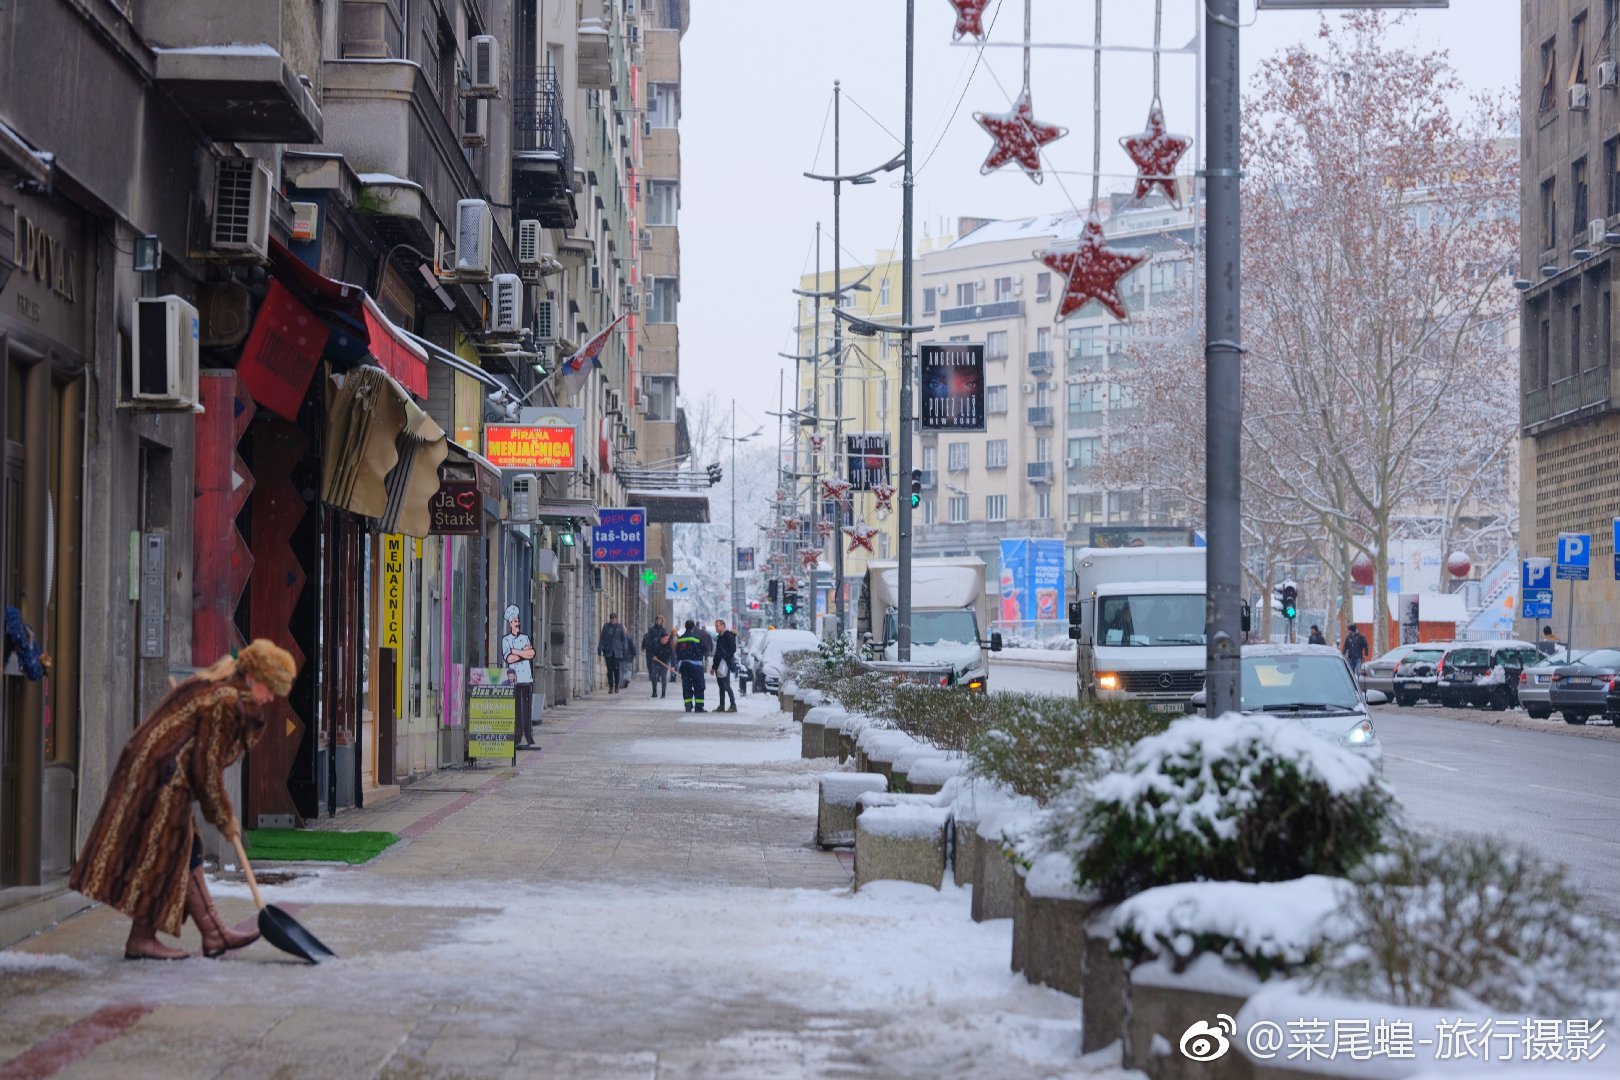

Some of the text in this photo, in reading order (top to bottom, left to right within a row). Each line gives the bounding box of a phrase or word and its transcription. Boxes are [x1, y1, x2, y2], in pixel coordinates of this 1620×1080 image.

[929, 351, 976, 366] ANGELLINA
[960, 395, 976, 417] LOŠ
[489, 439, 571, 457] MENJAČNICA
[497, 457, 562, 465] exchange office
[435, 492, 455, 508] Ja
[435, 508, 475, 526] Štark
[595, 530, 641, 542] taš-bet
[1564, 537, 1583, 563] P
[1528, 563, 1545, 586] P
[386, 539, 402, 644] MENJAČNICA
